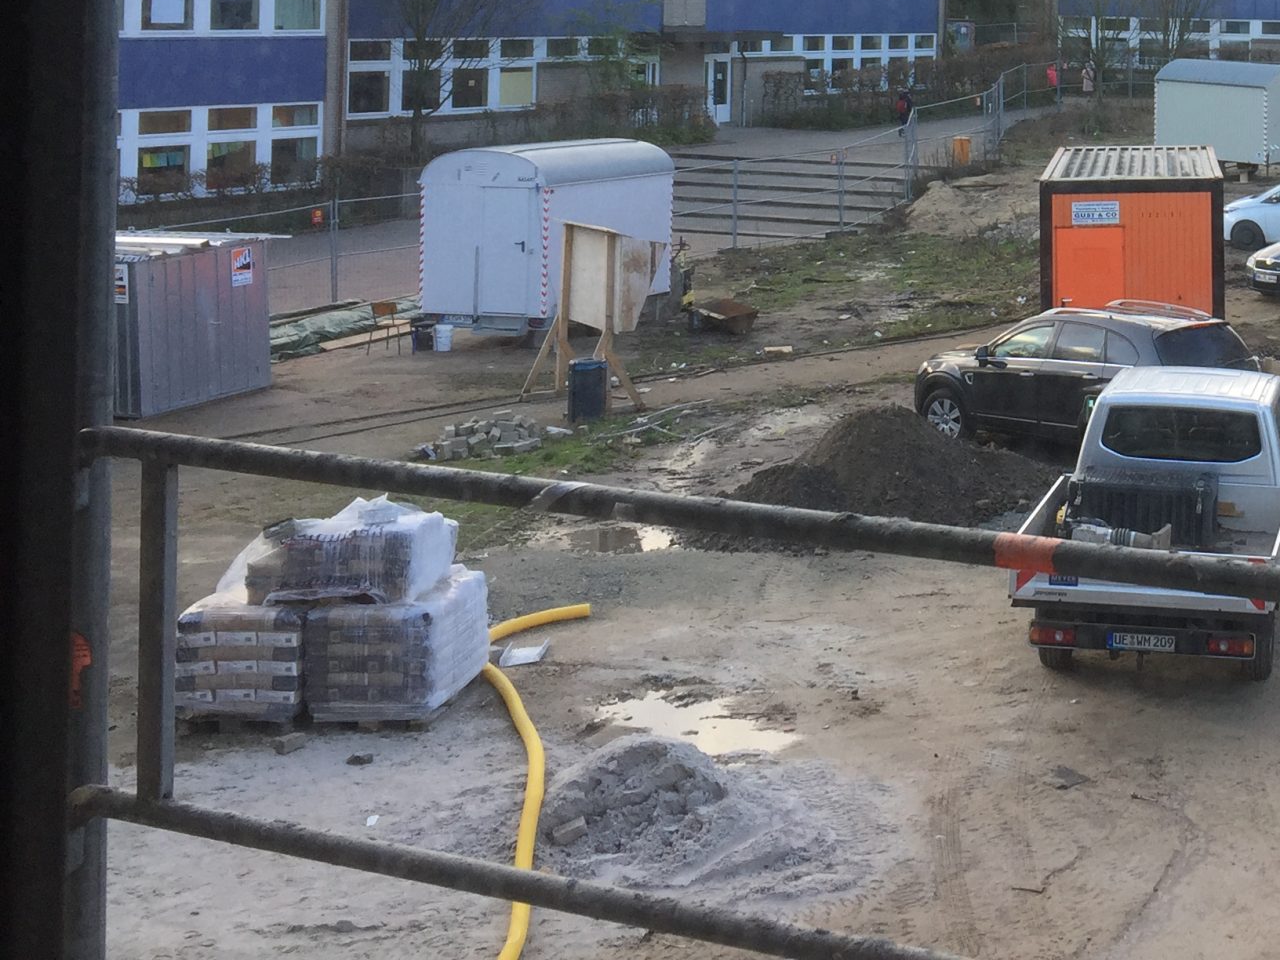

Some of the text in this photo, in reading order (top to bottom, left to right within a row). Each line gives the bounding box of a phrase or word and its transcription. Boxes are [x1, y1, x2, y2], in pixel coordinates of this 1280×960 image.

[1113, 634, 1174, 648] UE WM 209
